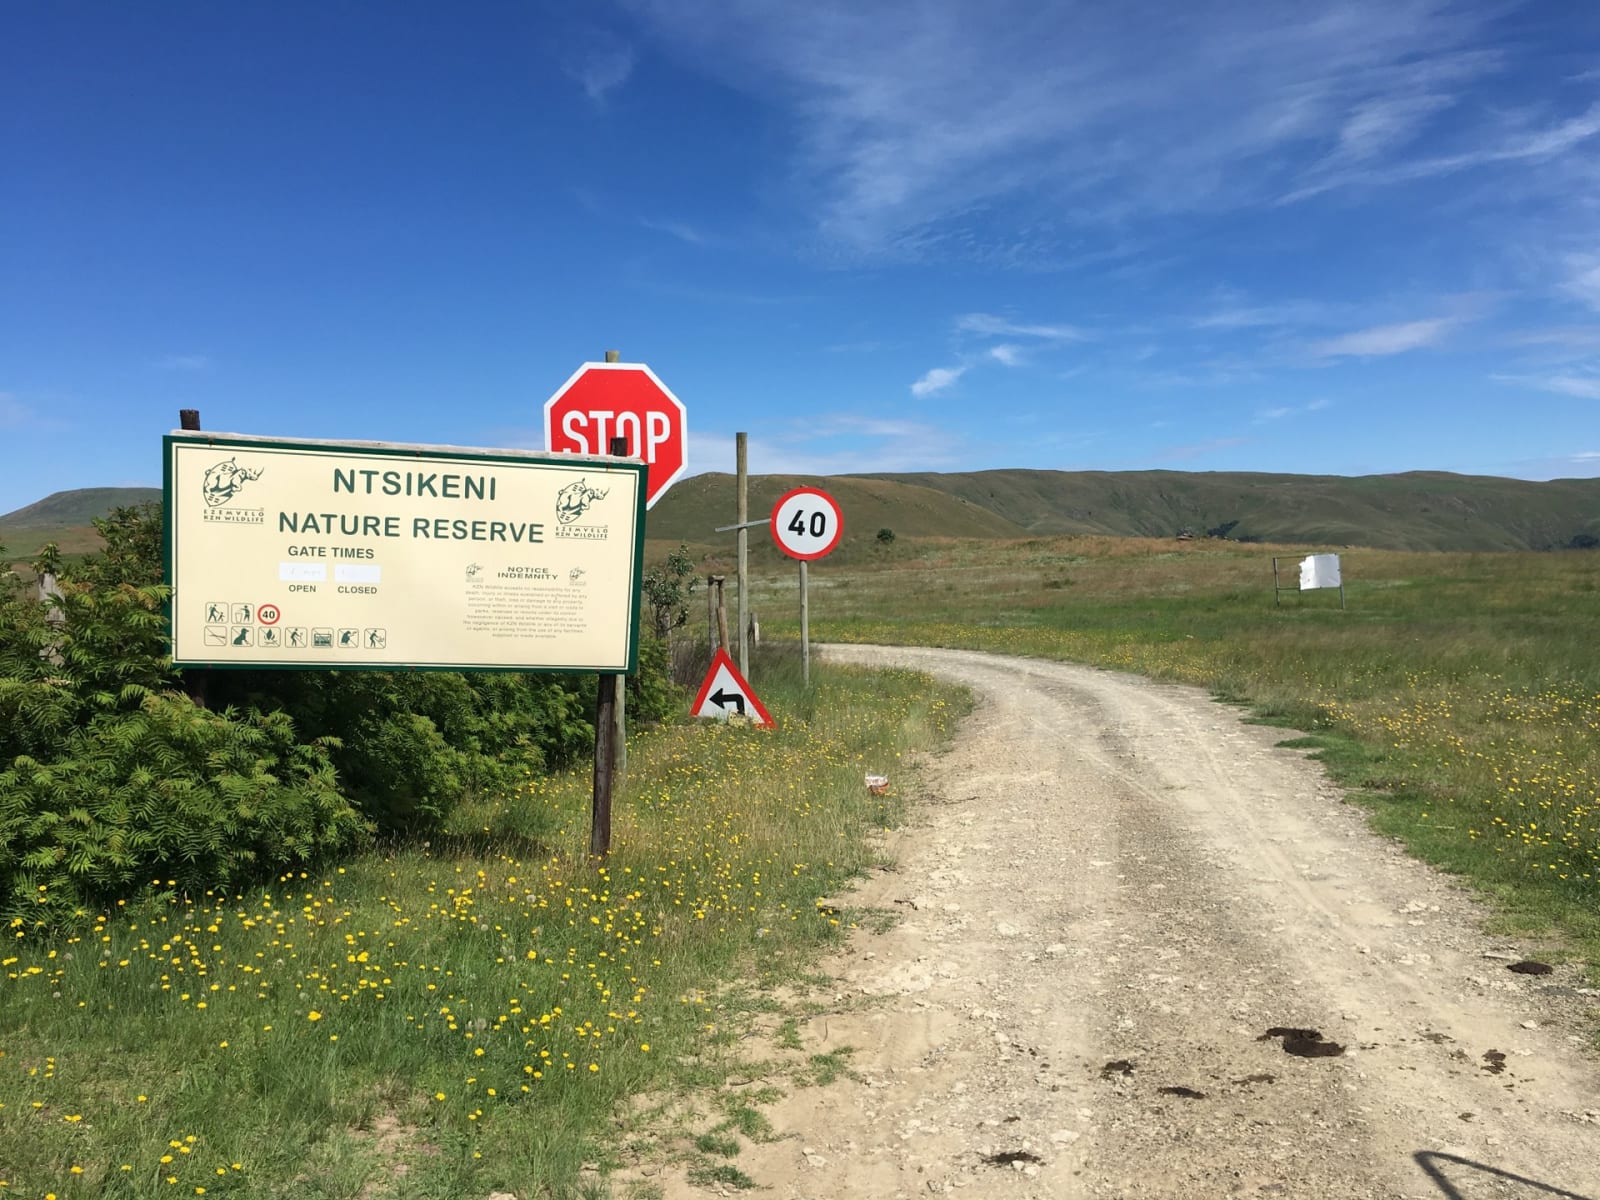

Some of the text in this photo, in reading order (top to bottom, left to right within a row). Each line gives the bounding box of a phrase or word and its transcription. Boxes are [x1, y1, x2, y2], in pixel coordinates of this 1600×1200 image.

[562, 410, 671, 464] STOP
[334, 467, 496, 501] NTSIKENI
[203, 509, 264, 517] EZEMVELO
[279, 511, 545, 545] NATURE RESERVE
[788, 509, 826, 538] 40
[555, 526, 608, 534] EZEMVELO
[288, 545, 375, 560] GATE TIMES
[507, 566, 549, 574] NOTICE
[497, 572, 558, 580] INDEMNITY
[288, 584, 378, 595] OPEN CLOSED
[262, 610, 276, 620] 40
